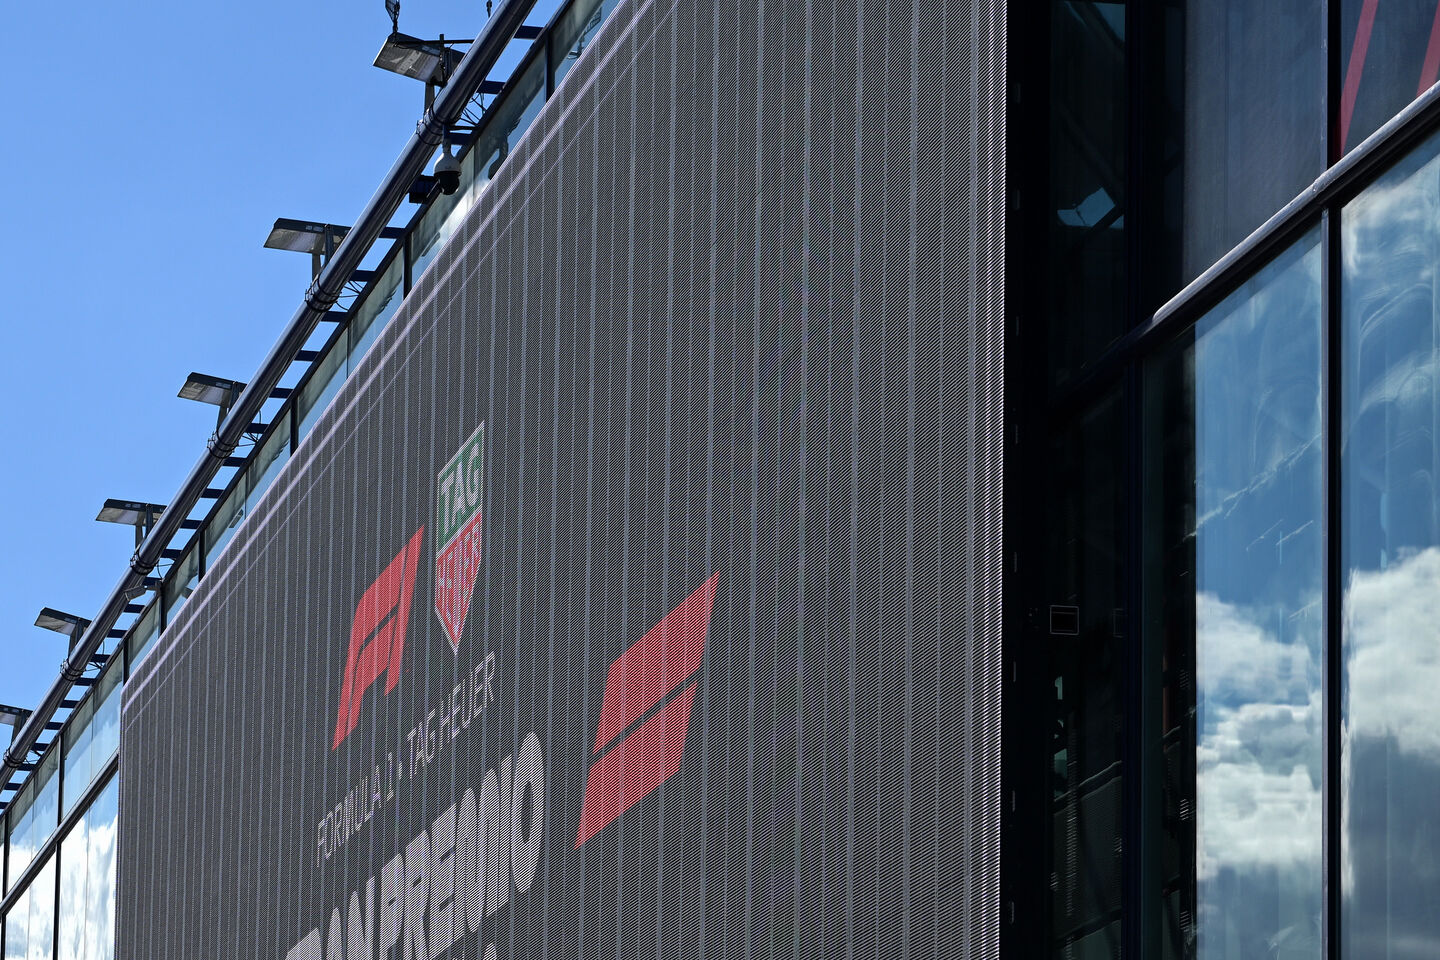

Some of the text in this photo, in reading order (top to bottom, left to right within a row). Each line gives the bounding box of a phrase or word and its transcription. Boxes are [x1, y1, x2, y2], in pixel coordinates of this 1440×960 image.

[441, 443, 480, 533] TAG
[438, 521, 480, 637] HEUER
[317, 651, 496, 868] FORMULA 1 TAG HEUER
